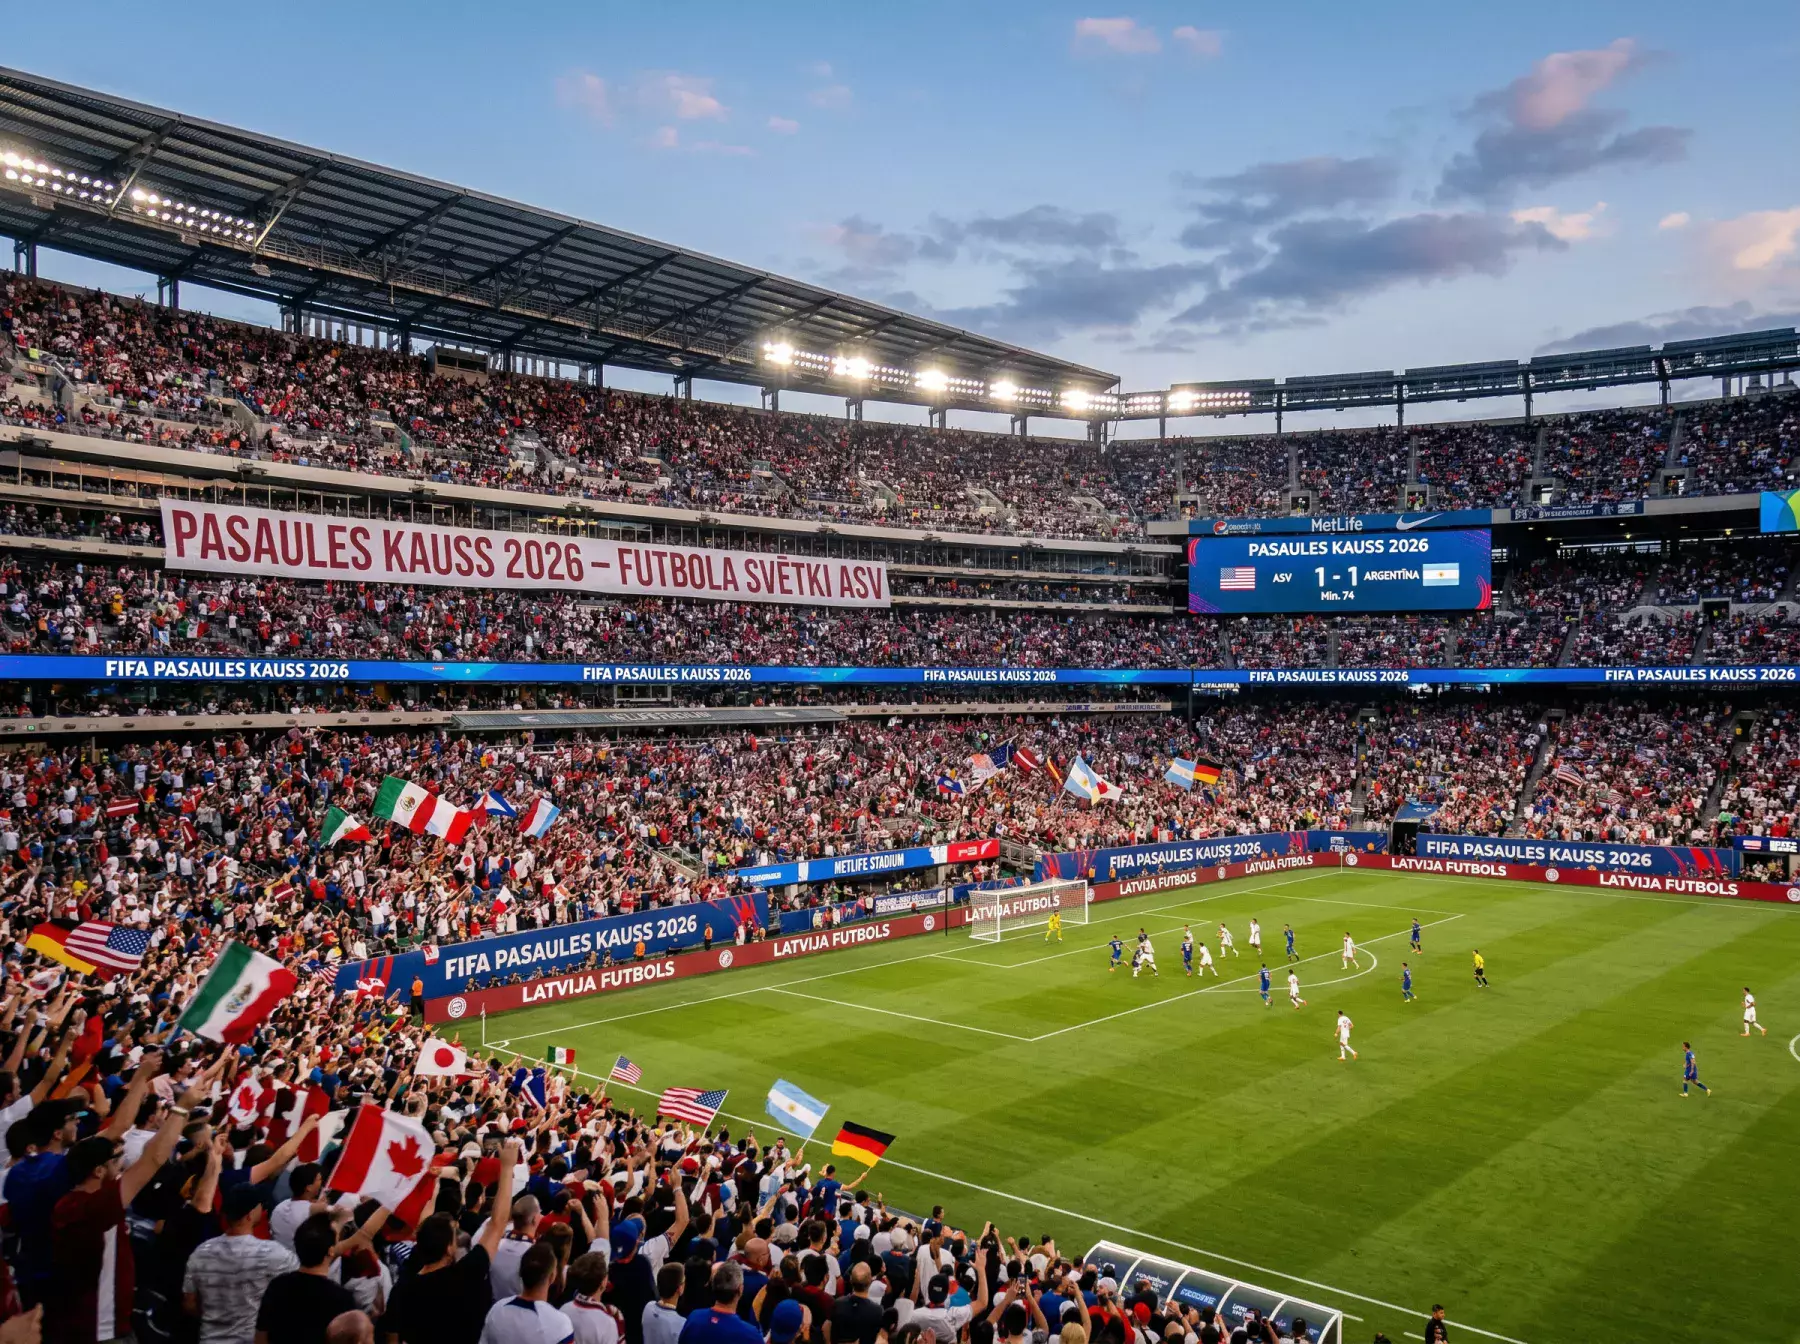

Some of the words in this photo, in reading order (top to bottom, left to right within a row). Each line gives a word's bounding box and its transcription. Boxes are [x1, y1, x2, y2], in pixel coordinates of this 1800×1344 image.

[1311, 516, 1363, 532] MetLife
[171, 509, 373, 571] PASAULES
[382, 526, 495, 578] KAUSS
[503, 538, 585, 582] 2026
[617, 547, 740, 592] FUTBOLA
[744, 555, 833, 598] SVĒTKI
[839, 565, 883, 600] ASV
[1248, 541, 1329, 557] PASAULES
[1332, 539, 1385, 555] KAUSS
[1388, 538, 1429, 553] 2026
[1272, 573, 1293, 583] ASV
[1314, 566, 1325, 587] 1
[1347, 566, 1358, 587] 1
[1363, 567, 1420, 581] ARGENTĪNA
[1320, 590, 1341, 601] Min.
[1342, 590, 1356, 601] 74
[105, 660, 149, 678] FIFA
[152, 660, 246, 678] PASAULES
[250, 662, 306, 678] KAUSS
[309, 663, 350, 679] 2026
[583, 667, 613, 680] FIFA
[615, 667, 679, 681] PASAULES
[681, 668, 721, 681] KAUSS
[723, 668, 752, 681] 2026
[923, 670, 947, 681] FIFA
[948, 670, 998, 681] PASAULES
[999, 670, 1031, 681] KAUSS
[1032, 670, 1057, 682] 2026
[1249, 671, 1276, 682] FIFA
[1277, 671, 1336, 682] PASAULES
[1338, 671, 1377, 682] KAUSS
[1379, 671, 1409, 682] 2026
[1605, 669, 1635, 681] FIFA
[1637, 669, 1707, 681] PASAULES
[1709, 668, 1757, 681] KAUSS
[1760, 668, 1796, 681] 2026
[1109, 854, 1135, 869] FIFA
[1136, 847, 1194, 866] PASAULES
[1195, 844, 1232, 860] KAUSS
[1233, 841, 1262, 856] 2026
[1426, 840, 1461, 855] FIFA
[1463, 842, 1546, 860] PASAULES
[1549, 847, 1606, 864] KAUSS
[1609, 851, 1652, 867] 2026
[834, 857, 869, 875] METLIFE
[869, 853, 905, 870] STADIUM
[1244, 859, 1276, 873] LATVIJA
[1277, 854, 1314, 869] FUTBOLS
[1391, 857, 1443, 873] LATVIJA
[1444, 861, 1507, 877] FUTBOLS
[1119, 878, 1157, 895] LATVIJA
[1158, 871, 1197, 888] FUTBOLS
[1599, 873, 1662, 890] LATVIJA
[1665, 877, 1739, 896] FUTBOLS
[1013, 895, 1060, 914] FUTBOLS
[445, 952, 491, 980] FIFA
[495, 933, 592, 970] PASAULES
[596, 923, 654, 950] KAUSS
[657, 914, 698, 938] 2026
[773, 934, 829, 957] LATVIJA
[831, 923, 891, 947] FUTBOLS
[522, 975, 598, 1003] LATVIJA
[600, 960, 676, 988] FUTBOLS
